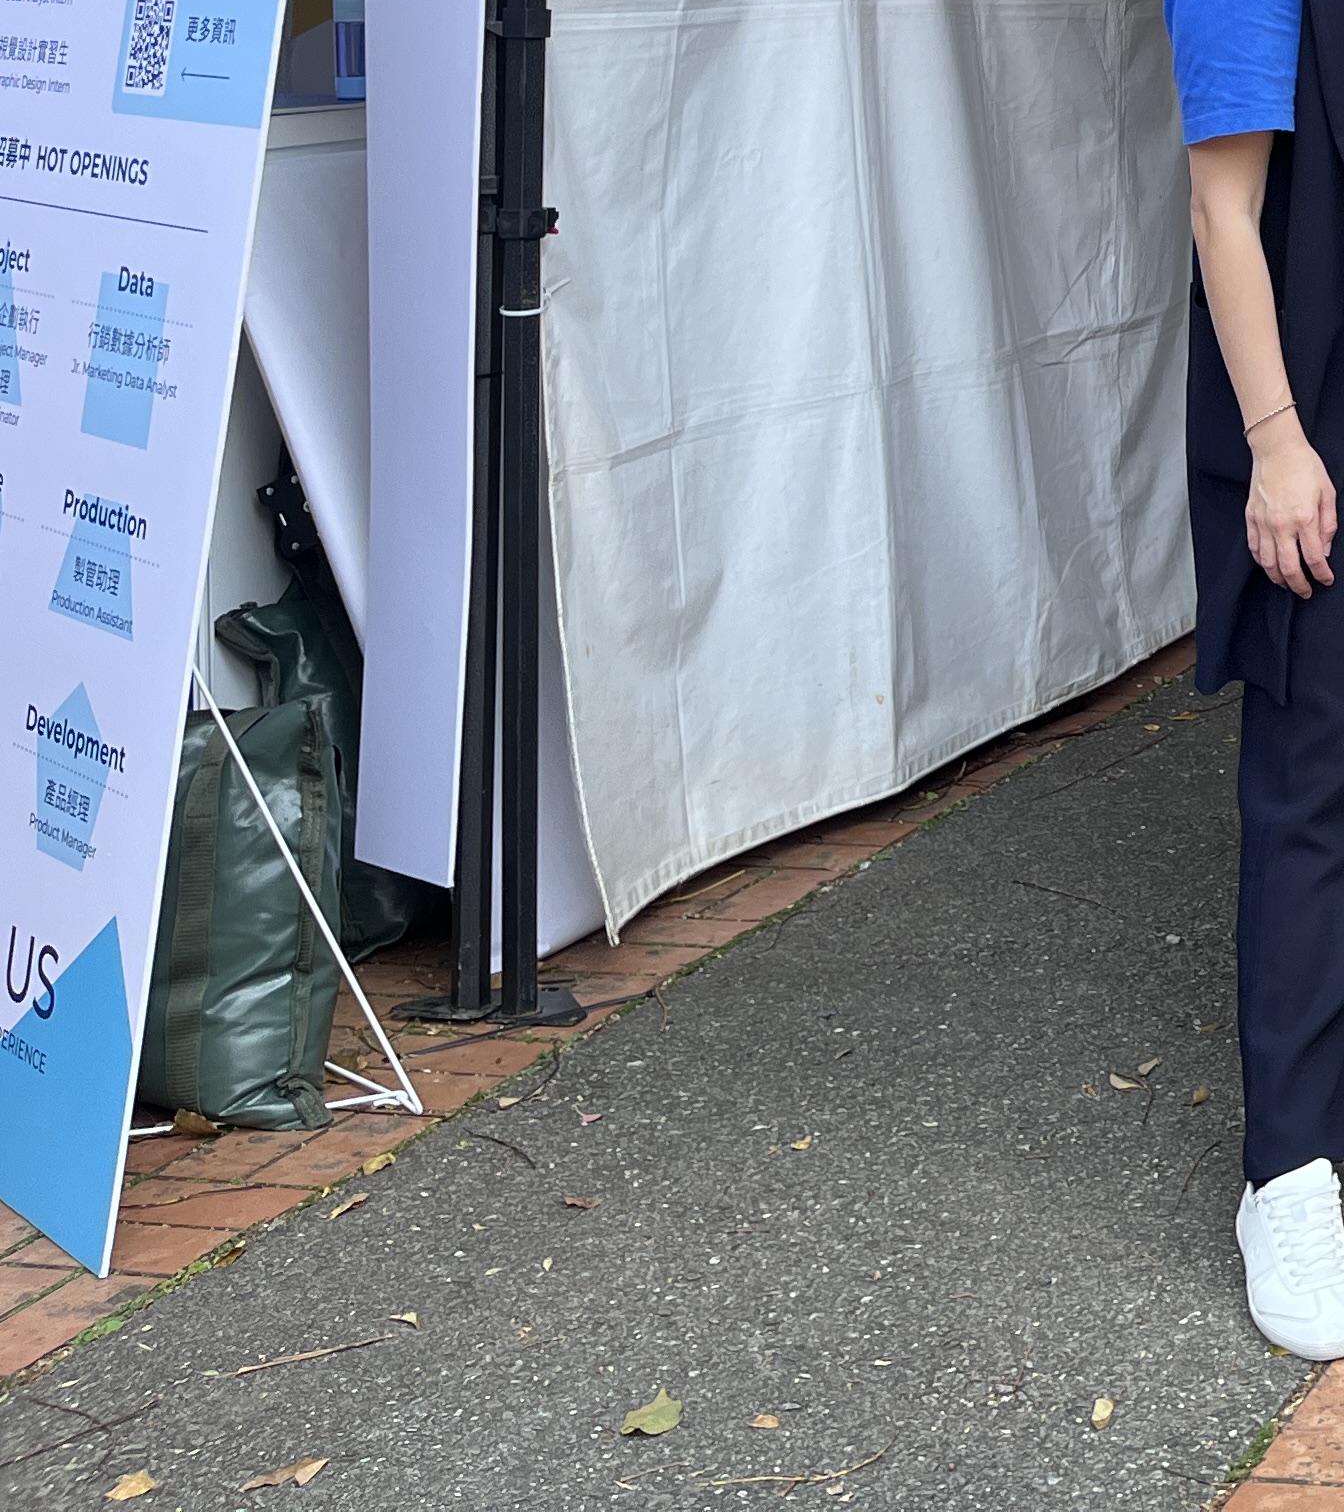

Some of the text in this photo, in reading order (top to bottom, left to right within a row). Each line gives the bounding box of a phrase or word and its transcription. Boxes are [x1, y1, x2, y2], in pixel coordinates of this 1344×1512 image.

[185, 16, 236, 45] 更多資訊
[21, 75, 46, 94] Design
[48, 78, 70, 94] Intern
[36, 145, 68, 173] HOT
[69, 150, 149, 186] OPENINGS
[118, 265, 155, 298] Data
[15, 345, 48, 368] Manager
[87, 321, 172, 366] 行銷數據分析師
[81, 360, 123, 389] Marketing
[124, 371, 144, 390] Data
[145, 377, 178, 400] Analyst
[63, 488, 147, 541] Production
[51, 589, 133, 635] Production Assistant
[26, 703, 126, 774] Development
[29, 812, 97, 860] Product Manager
[7, 925, 59, 1020] US
